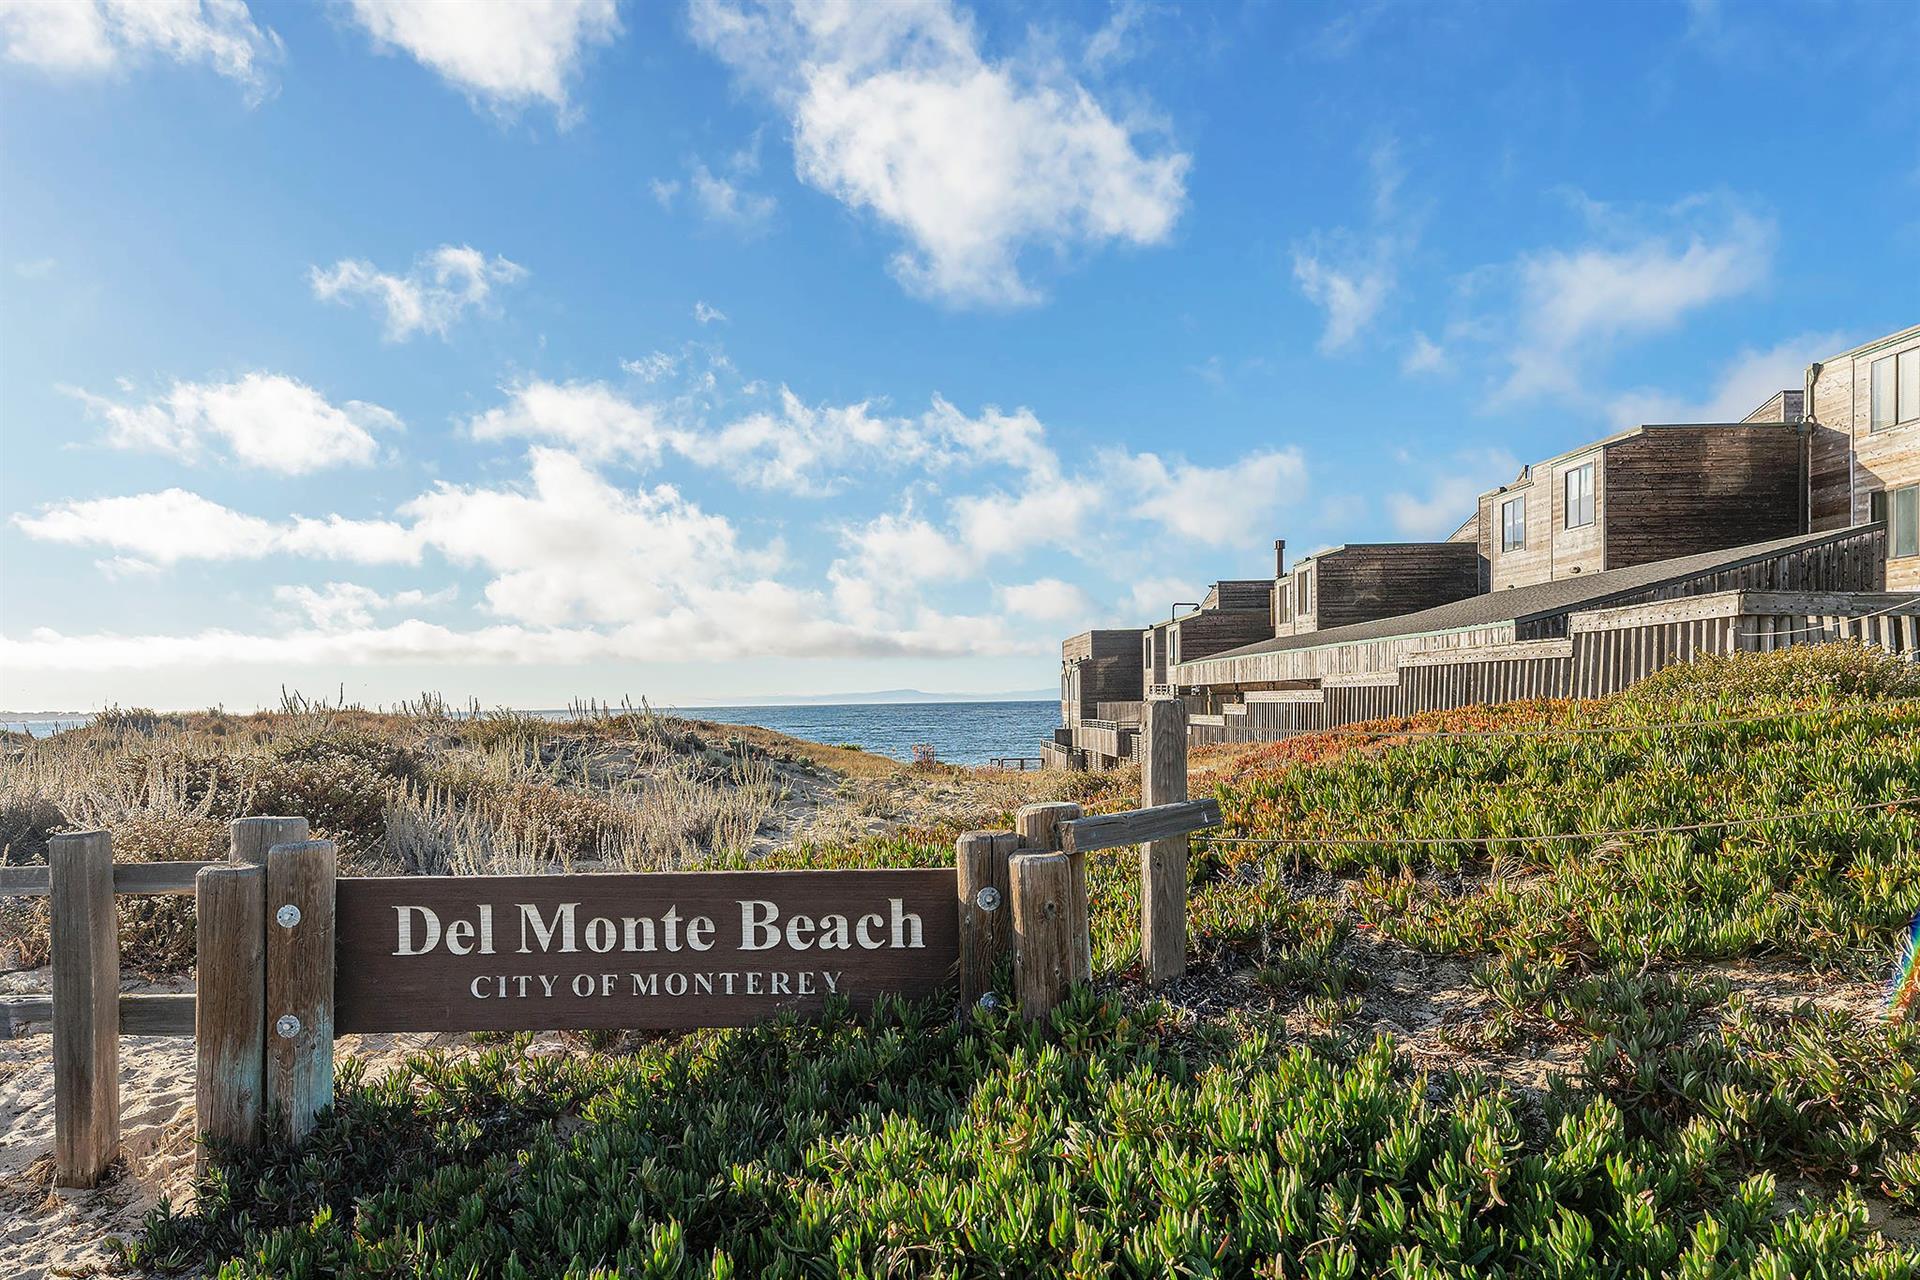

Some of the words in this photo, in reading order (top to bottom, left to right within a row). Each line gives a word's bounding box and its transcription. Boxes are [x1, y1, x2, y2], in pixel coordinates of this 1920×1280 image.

[391, 903, 497, 957] Del
[514, 902, 717, 956] Monte
[735, 898, 927, 953] Beach
[470, 974, 560, 1000] CITY
[571, 973, 619, 998] OF
[630, 971, 843, 998] MONTEREY
